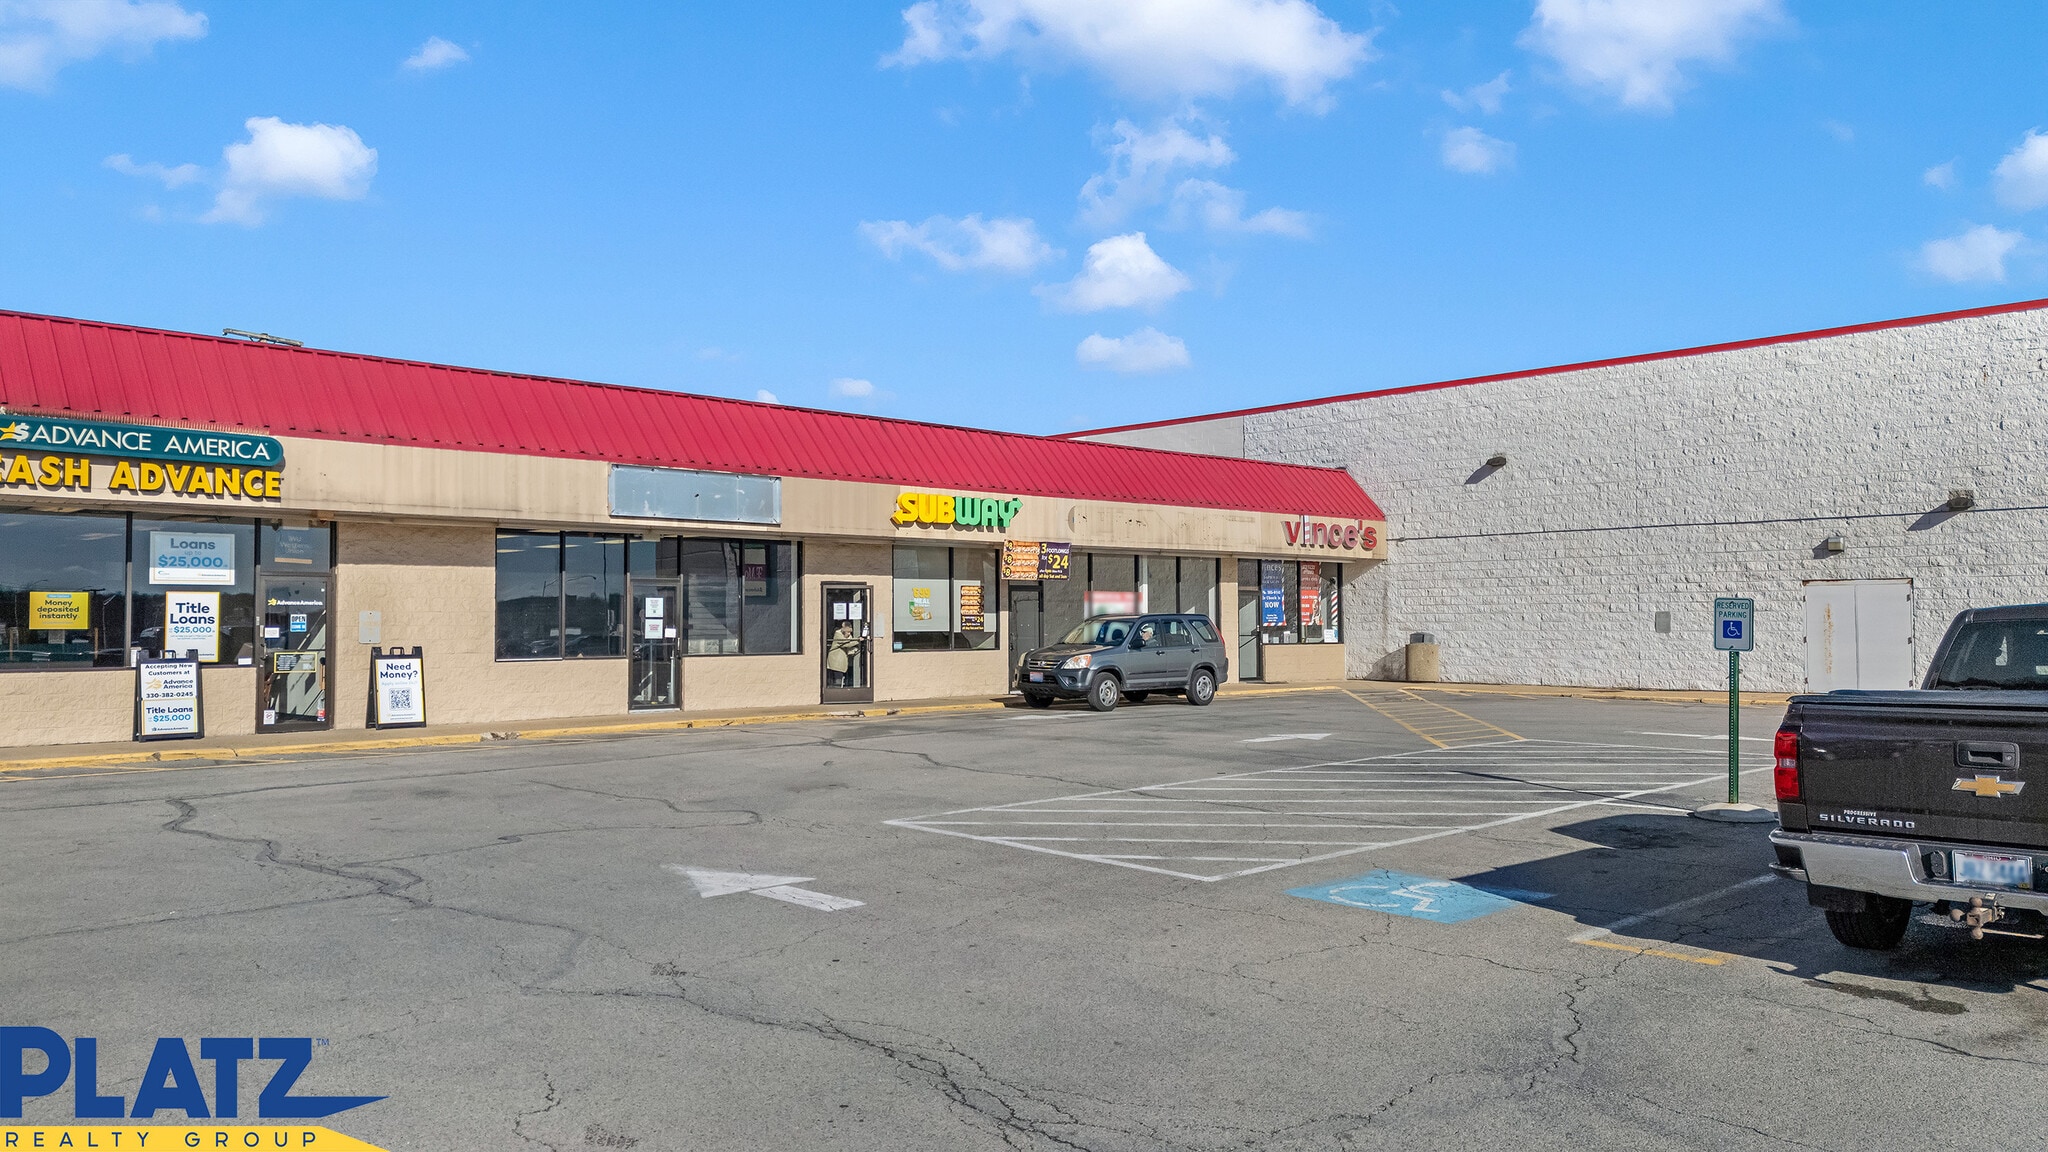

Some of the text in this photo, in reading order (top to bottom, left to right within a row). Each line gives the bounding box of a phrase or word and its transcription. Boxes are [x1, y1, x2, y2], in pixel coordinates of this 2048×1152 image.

[31, 425, 270, 460] ADVANCE AMERICA
[0, 453, 281, 498] ASH ADVANCE
[891, 492, 1024, 528] SUBWAY
[170, 538, 216, 550] Loans
[1041, 543, 1047, 554] 3
[158, 554, 223, 568] $25,000
[1048, 554, 1069, 569] $24
[176, 602, 210, 614] Title
[170, 614, 216, 624] Loans
[174, 626, 212, 634] $25,000
[380, 670, 418, 680] Money?
[1819, 814, 1915, 828] SILVERADO
